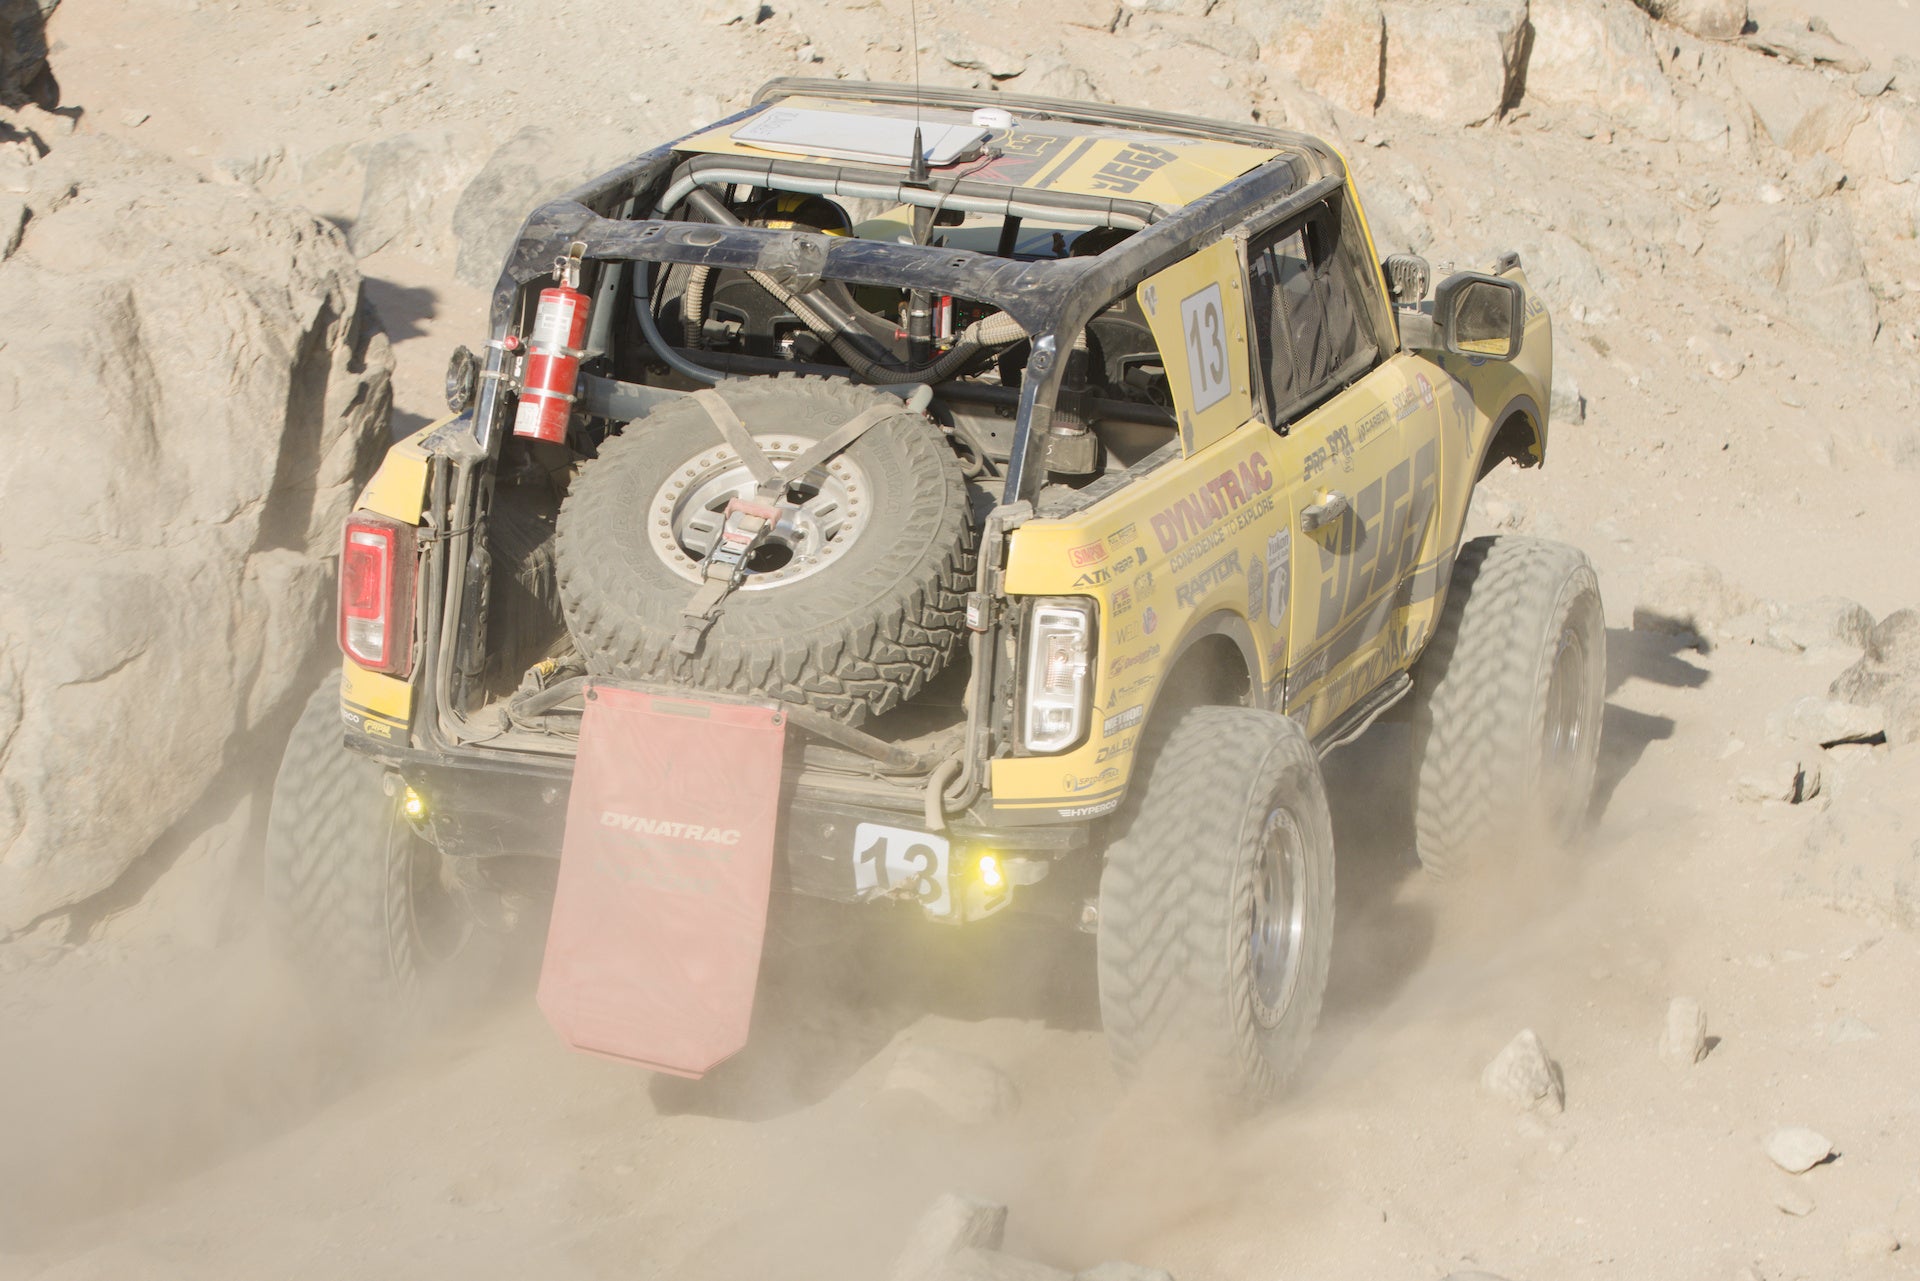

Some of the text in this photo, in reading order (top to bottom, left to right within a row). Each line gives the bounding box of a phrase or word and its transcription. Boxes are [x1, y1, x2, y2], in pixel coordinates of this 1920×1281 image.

[1189, 302, 1224, 392] 13
[1151, 452, 1273, 554] DYNATRAC
[1170, 528, 1225, 574] CONFIDENCE
[1238, 496, 1274, 530] EXPLORE
[1072, 567, 1111, 587] ATK
[1175, 547, 1244, 610] RAPTOR
[600, 811, 742, 846] DYNATRAC
[1071, 800, 1118, 816] HYPERCO
[860, 836, 942, 904] 13
